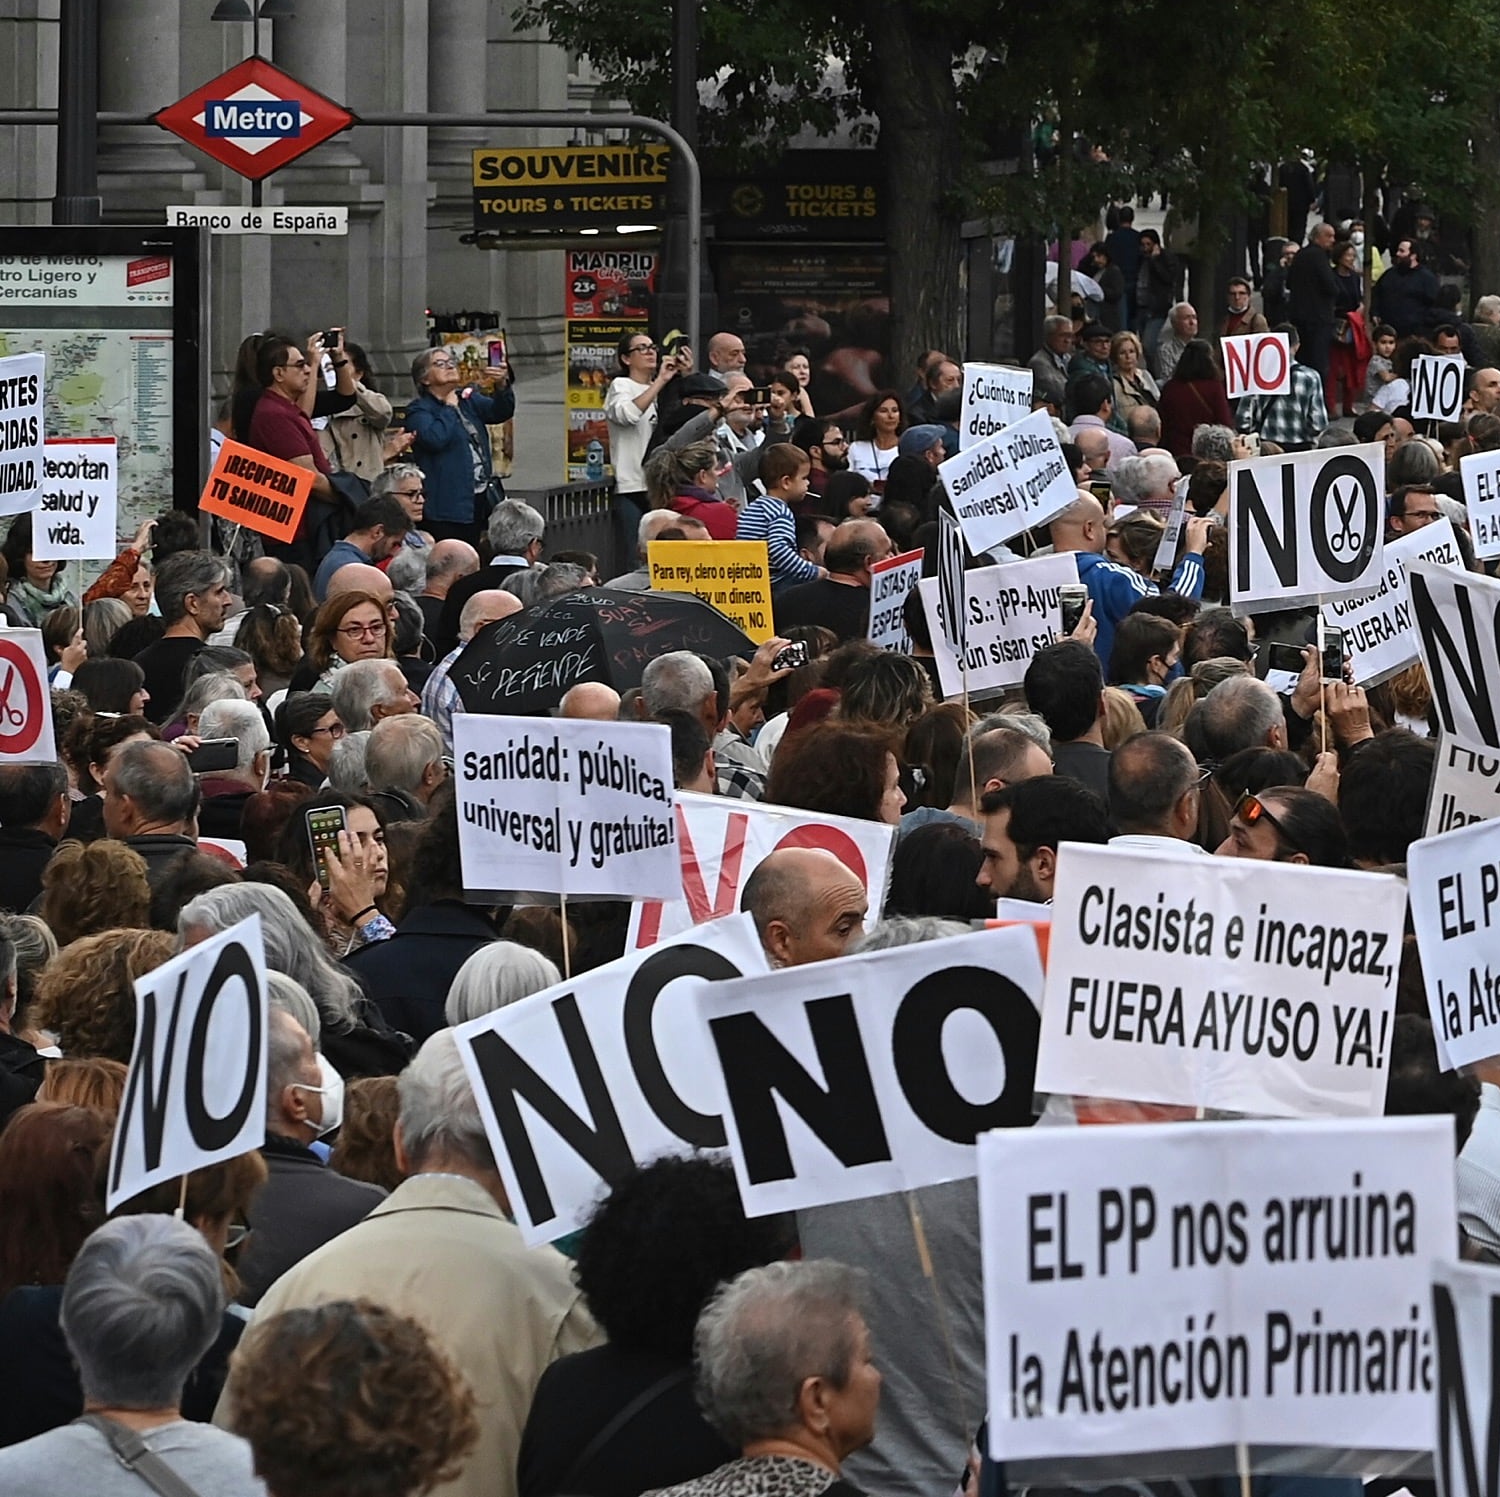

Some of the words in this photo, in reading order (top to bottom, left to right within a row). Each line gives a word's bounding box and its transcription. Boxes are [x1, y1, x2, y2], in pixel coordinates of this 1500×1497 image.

[213, 106, 294, 131] Metro
[479, 151, 670, 180] SOUVENIRS
[480, 196, 547, 213] TOURS
[553, 198, 564, 211] &
[570, 195, 653, 212] TICKETS
[786, 185, 856, 200] TOURS
[863, 186, 876, 199] &
[786, 201, 877, 217] TICKETS
[176, 211, 233, 230] Banco
[242, 211, 263, 230] de
[273, 211, 338, 233] España
[28, 269, 83, 285] Ligero
[88, 273, 97, 285] y
[570, 252, 654, 273] MADRID
[1225, 336, 1287, 394] NO
[1414, 358, 1460, 417] NO
[223, 454, 298, 498] ¡RECUPERA
[1477, 472, 1495, 502] EL
[41, 489, 83, 512] salud
[87, 495, 99, 518] y
[211, 478, 230, 501] TU
[229, 483, 294, 525] SANIDAD!
[48, 525, 85, 546] vida.
[1237, 454, 1378, 593] NO
[653, 563, 675, 580] Para
[677, 566, 694, 584] rey,
[696, 563, 718, 580] clero
[720, 567, 726, 580] o
[727, 563, 763, 583] ejército
[874, 568, 906, 603] LISTAS
[906, 563, 919, 589] de
[715, 590, 729, 604] un
[730, 589, 766, 605] dinero.
[749, 612, 767, 629] NO.
[463, 800, 562, 854] universal
[567, 818, 584, 868] y
[589, 814, 675, 869] gratuita!
[1437, 874, 1476, 942] EL
[1078, 883, 1214, 958] Clasista
[1224, 913, 1246, 960] e
[1253, 900, 1394, 988] incapaz,
[1063, 977, 1187, 1050] FUERA
[1193, 994, 1321, 1062] AYUSO
[1330, 1004, 1389, 1069] YA!
[111, 941, 262, 1195] NO
[470, 943, 744, 1226] NO
[709, 964, 1043, 1186] NO
[1027, 1192, 1085, 1285] EL
[1098, 1186, 1158, 1277] PP
[1170, 1197, 1249, 1274] nos
[1263, 1171, 1417, 1264] arruina
[1009, 1332, 1045, 1419] la
[1057, 1311, 1250, 1415] Atención
[1264, 1305, 1432, 1399] Primaria
